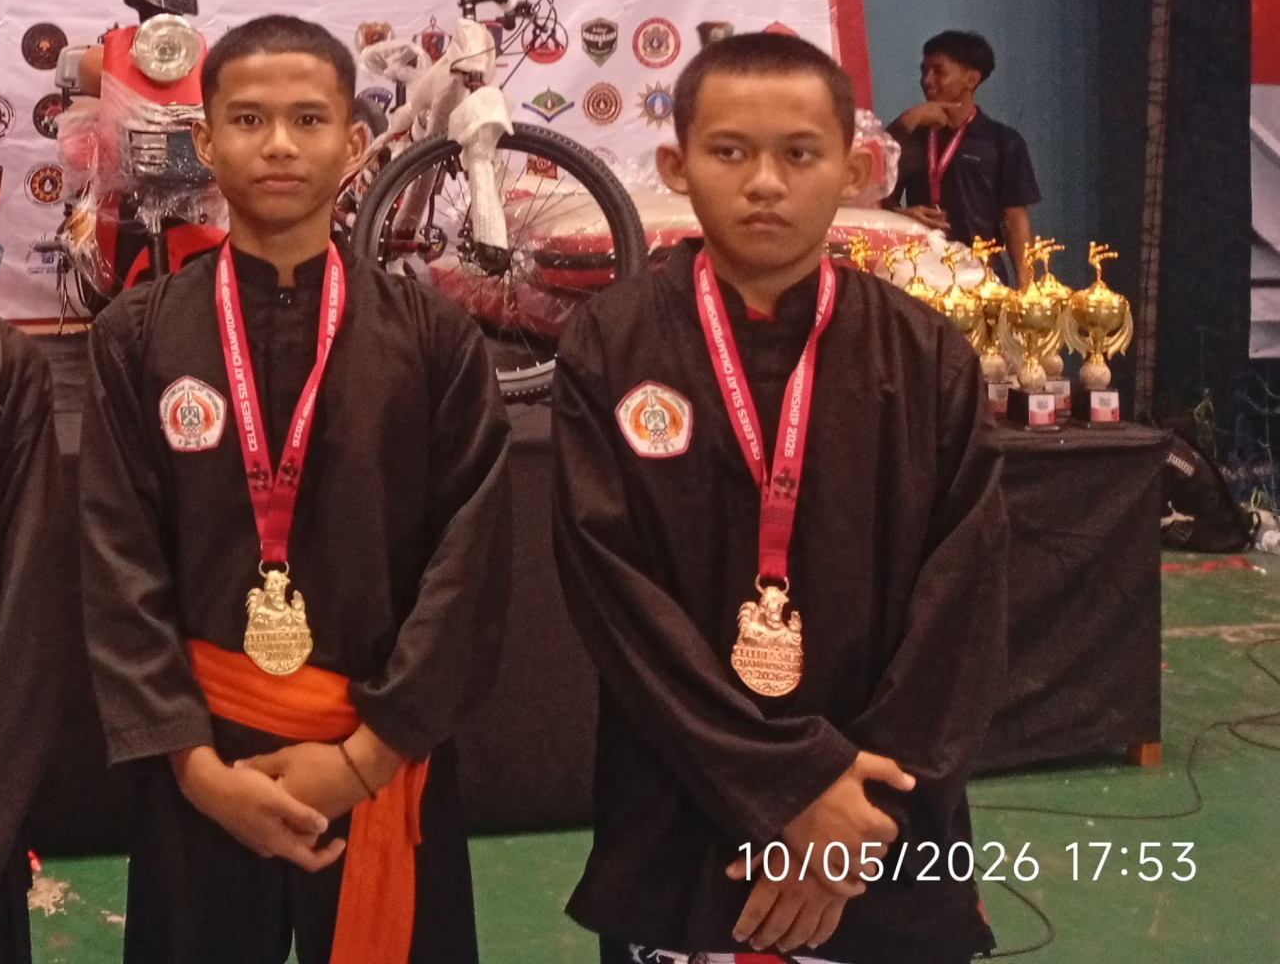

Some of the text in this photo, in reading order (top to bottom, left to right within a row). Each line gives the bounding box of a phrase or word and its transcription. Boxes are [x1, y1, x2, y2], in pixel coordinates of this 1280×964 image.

[221, 285, 242, 366] CHAMPIONSHIP
[703, 293, 734, 375] CHAMPIONSHIP
[234, 368, 248, 399] SILAT
[726, 376, 744, 408] SILAT
[240, 400, 258, 452] CELEBES
[292, 417, 306, 447] 2026
[737, 408, 761, 460] CELEBES
[784, 426, 798, 457] 2026
